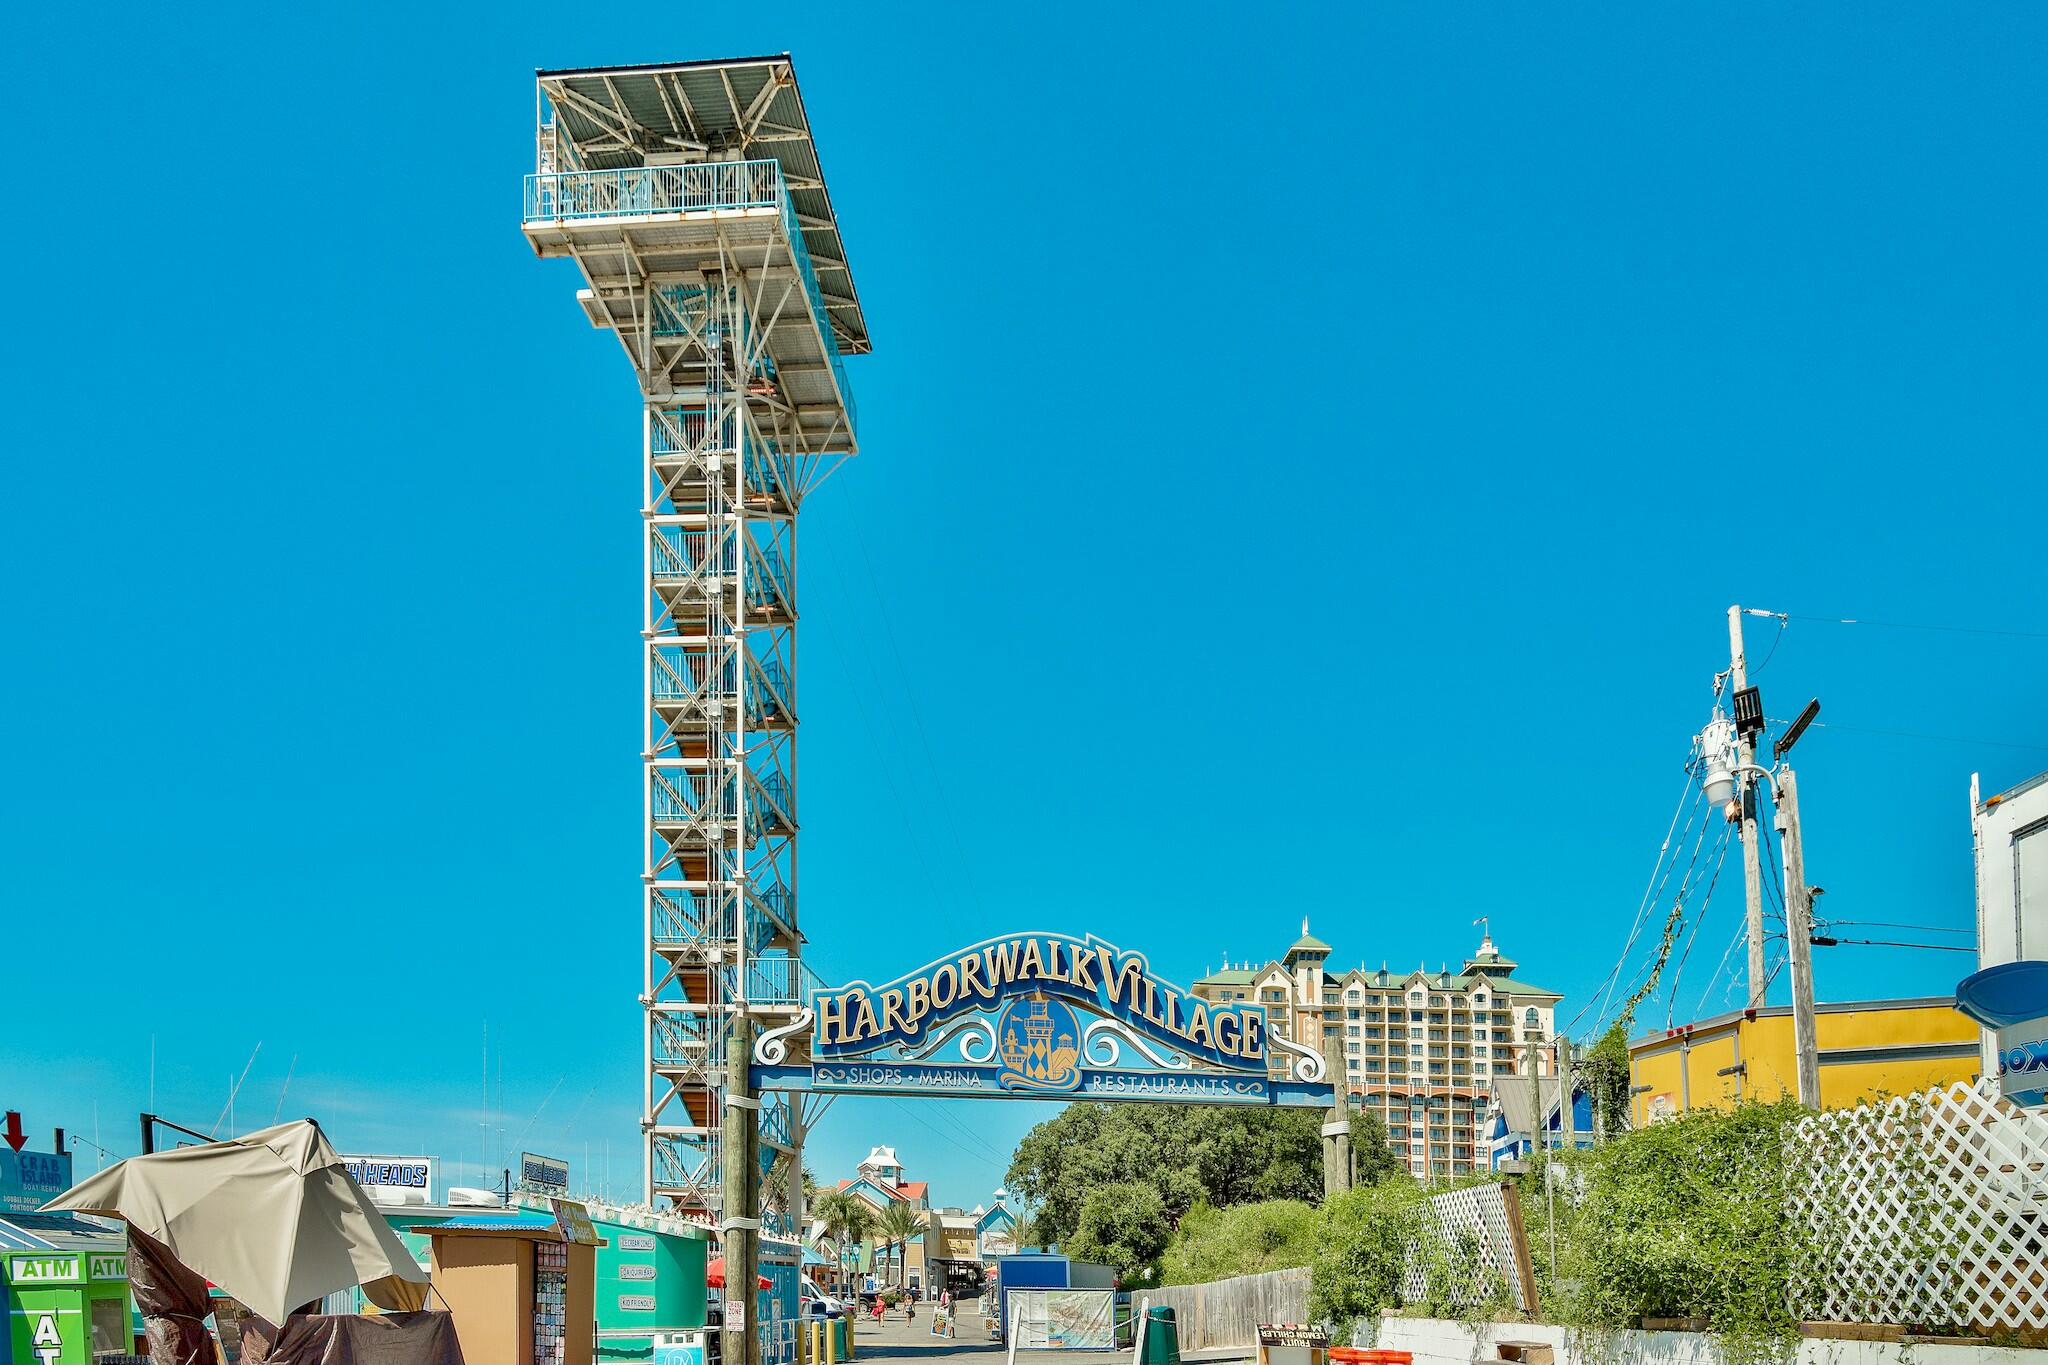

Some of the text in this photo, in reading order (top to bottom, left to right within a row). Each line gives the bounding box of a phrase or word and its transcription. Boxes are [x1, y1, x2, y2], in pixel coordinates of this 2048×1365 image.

[817, 938, 1263, 1059] HARBORWALK VILLAGE
[849, 1067, 982, 1088] SHOPS MARINA
[1093, 1075, 1230, 1095] RESTAURANTS
[20, 1155, 60, 1171] CRAB
[21, 1169, 63, 1185] ISLAND
[364, 1162, 427, 1187] HEADS
[23, 1183, 62, 1193] BOAT RENTAL
[22, 1259, 72, 1277] ATM
[92, 1259, 126, 1276] ATM
[631, 1299, 651, 1307] FRIENDLY
[1260, 1330, 1326, 1340] LEMON CHILLER
[1280, 1339, 1311, 1348] FRUITY
